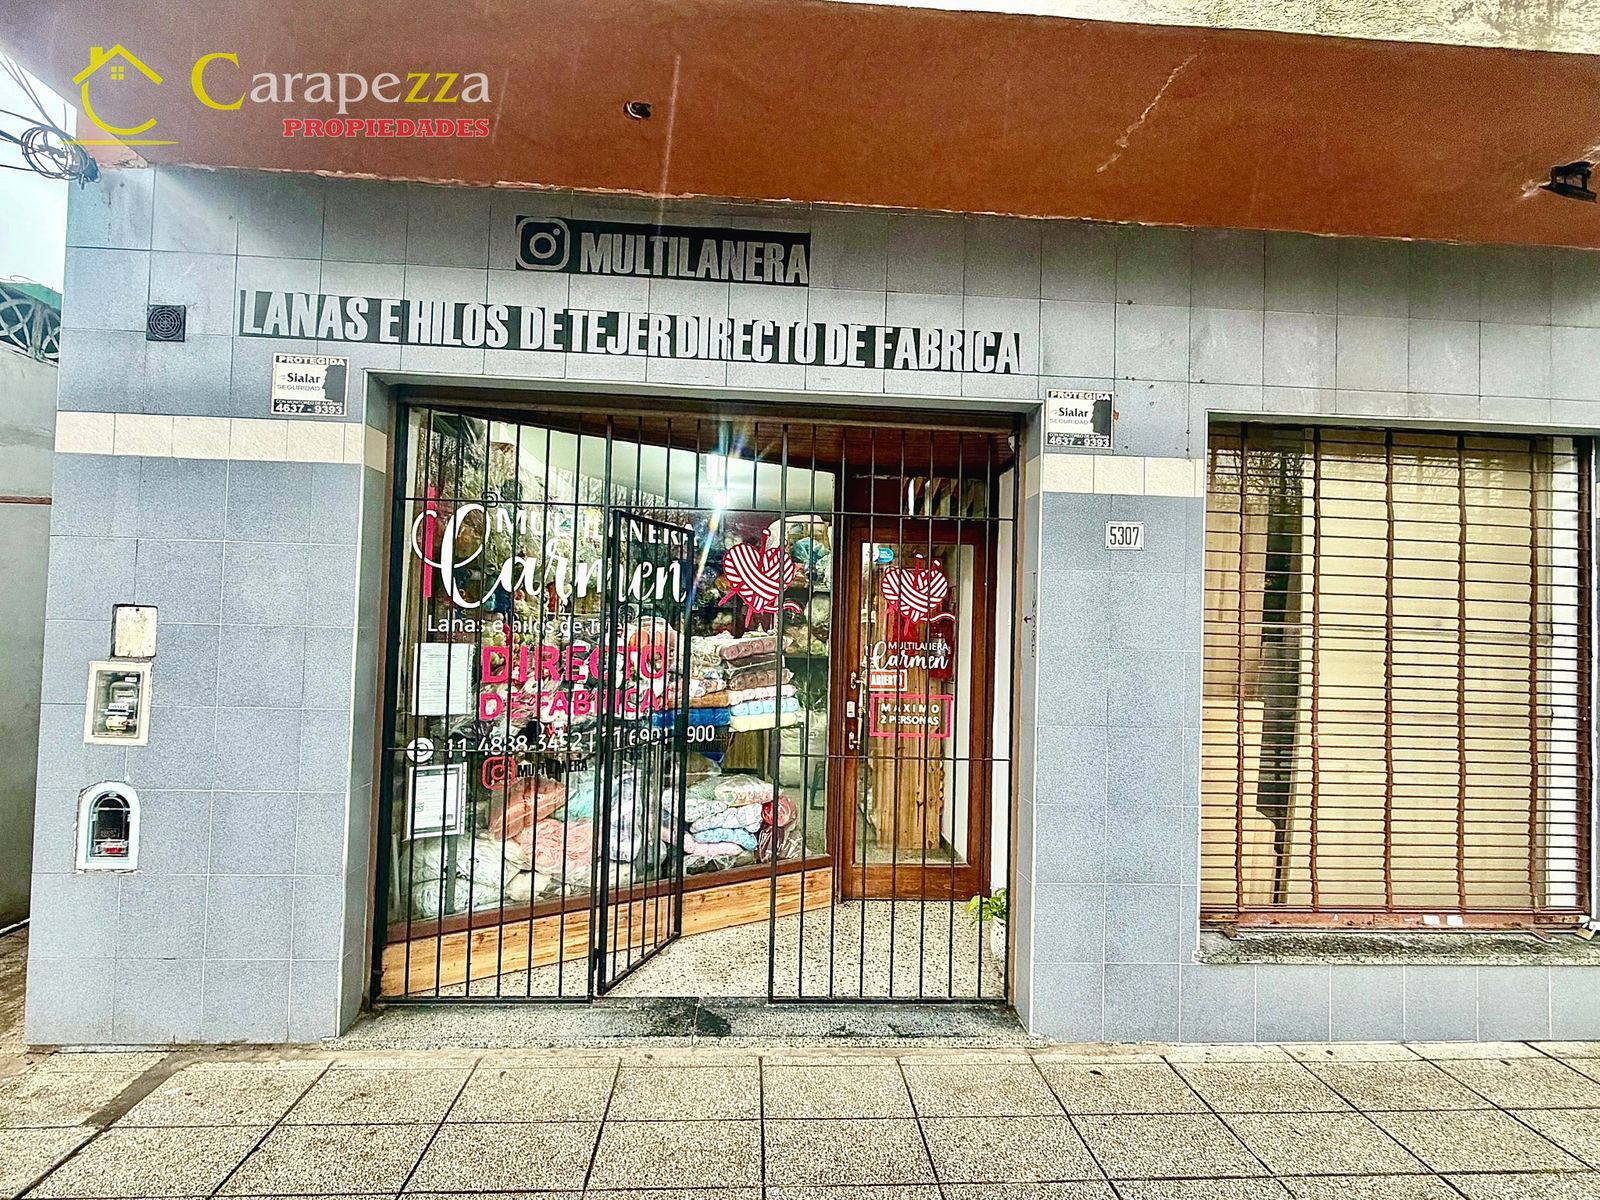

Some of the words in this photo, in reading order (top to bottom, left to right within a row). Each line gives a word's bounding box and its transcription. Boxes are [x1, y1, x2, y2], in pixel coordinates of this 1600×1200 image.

[579, 231, 809, 284] MULTILANERA
[242, 289, 369, 341] LANAS
[379, 299, 402, 344] E
[407, 299, 508, 348] HILOS
[519, 305, 566, 351] DE
[568, 308, 671, 357] TEJER
[675, 314, 817, 364] DIRECTO
[823, 322, 867, 368] DE
[874, 326, 1021, 374] FABRICA
[279, 355, 345, 366] PROTEGIDA
[287, 372, 321, 383] Sialar
[1051, 391, 1111, 400] PROTEGIDA
[276, 403, 304, 413] 4637
[315, 405, 343, 414] 9393
[1058, 407, 1089, 417] Sialar
[1049, 436, 1075, 446] 4637
[1084, 438, 1110, 448] 9393
[1109, 526, 1140, 546] 5307
[411, 503, 687, 609] Carmen
[428, 614, 484, 634] Lanas
[481, 643, 667, 684] DIRECTO
[865, 640, 949, 672] Carmen
[479, 691, 523, 721] DE
[880, 715, 887, 724] 2
[888, 716, 940, 725] PERSONAS
